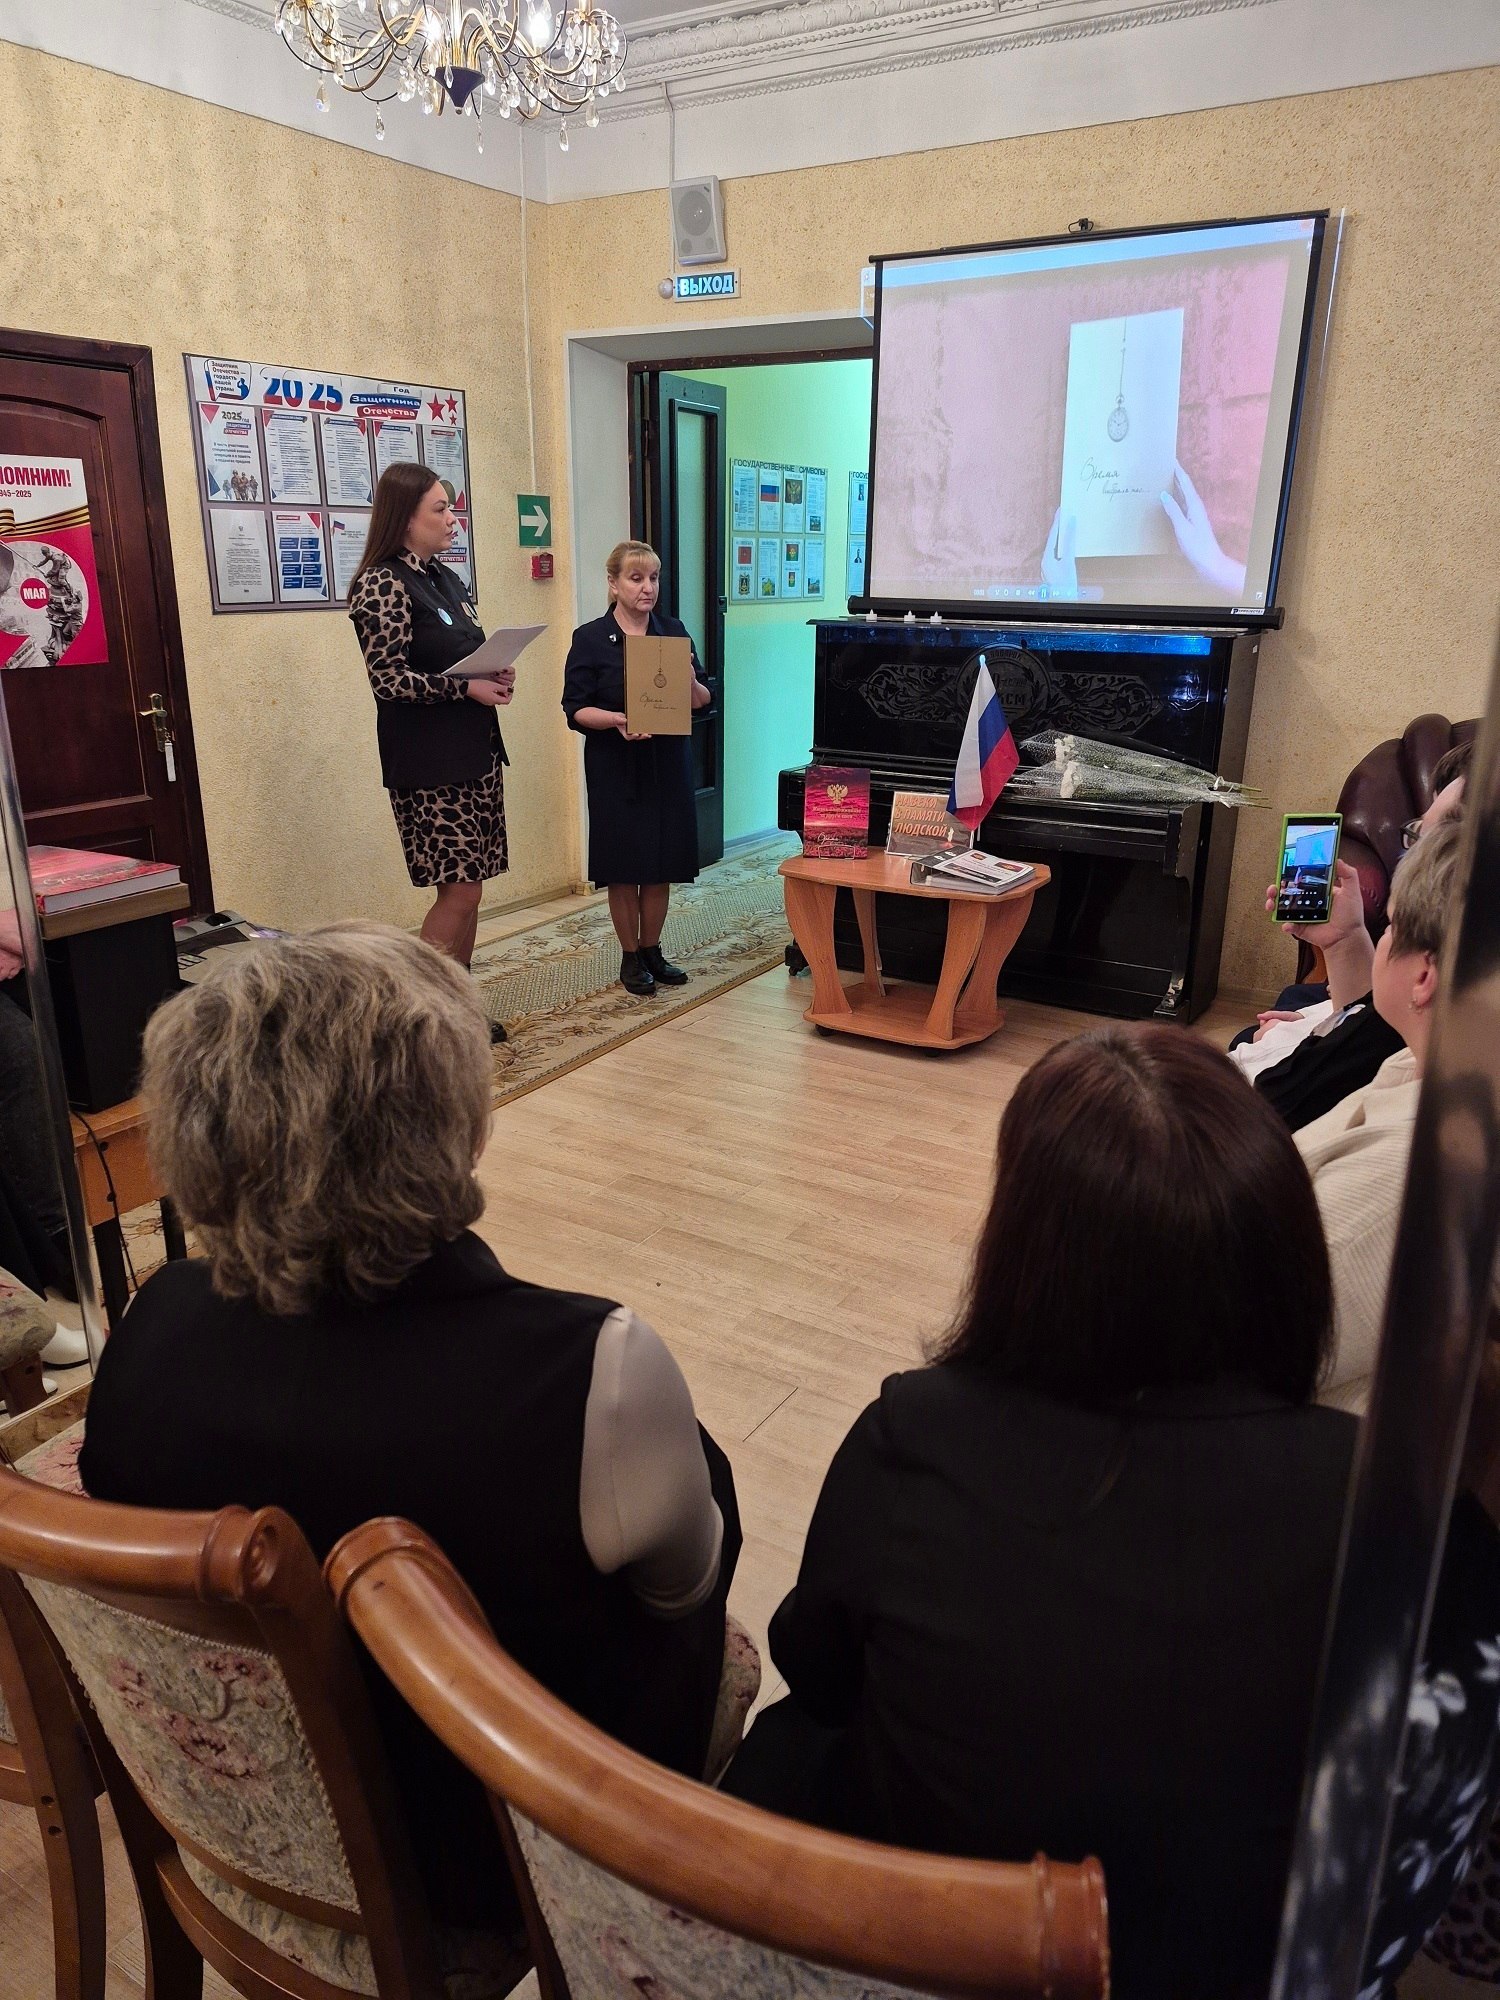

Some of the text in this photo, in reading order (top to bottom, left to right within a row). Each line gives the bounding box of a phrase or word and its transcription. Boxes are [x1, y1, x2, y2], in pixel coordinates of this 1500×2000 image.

[679, 274, 734, 296] ВЫХОД
[260, 367, 343, 412] 2025
[393, 386, 410, 394] Год
[352, 395, 420, 407] Защитника
[221, 411, 242, 421] 2025
[362, 407, 415, 417] Отечества
[733, 459, 796, 473] ГОСУДАРСТВЕННЫЕ
[798, 466, 826, 476] СИМВОЛЫ
[22, 587, 47, 601] МАЯ
[895, 795, 938, 809] НАВЕКИ
[895, 809, 945, 823] В ПАМЯТИ
[895, 822, 948, 838] ЛЮДСКОЙ
